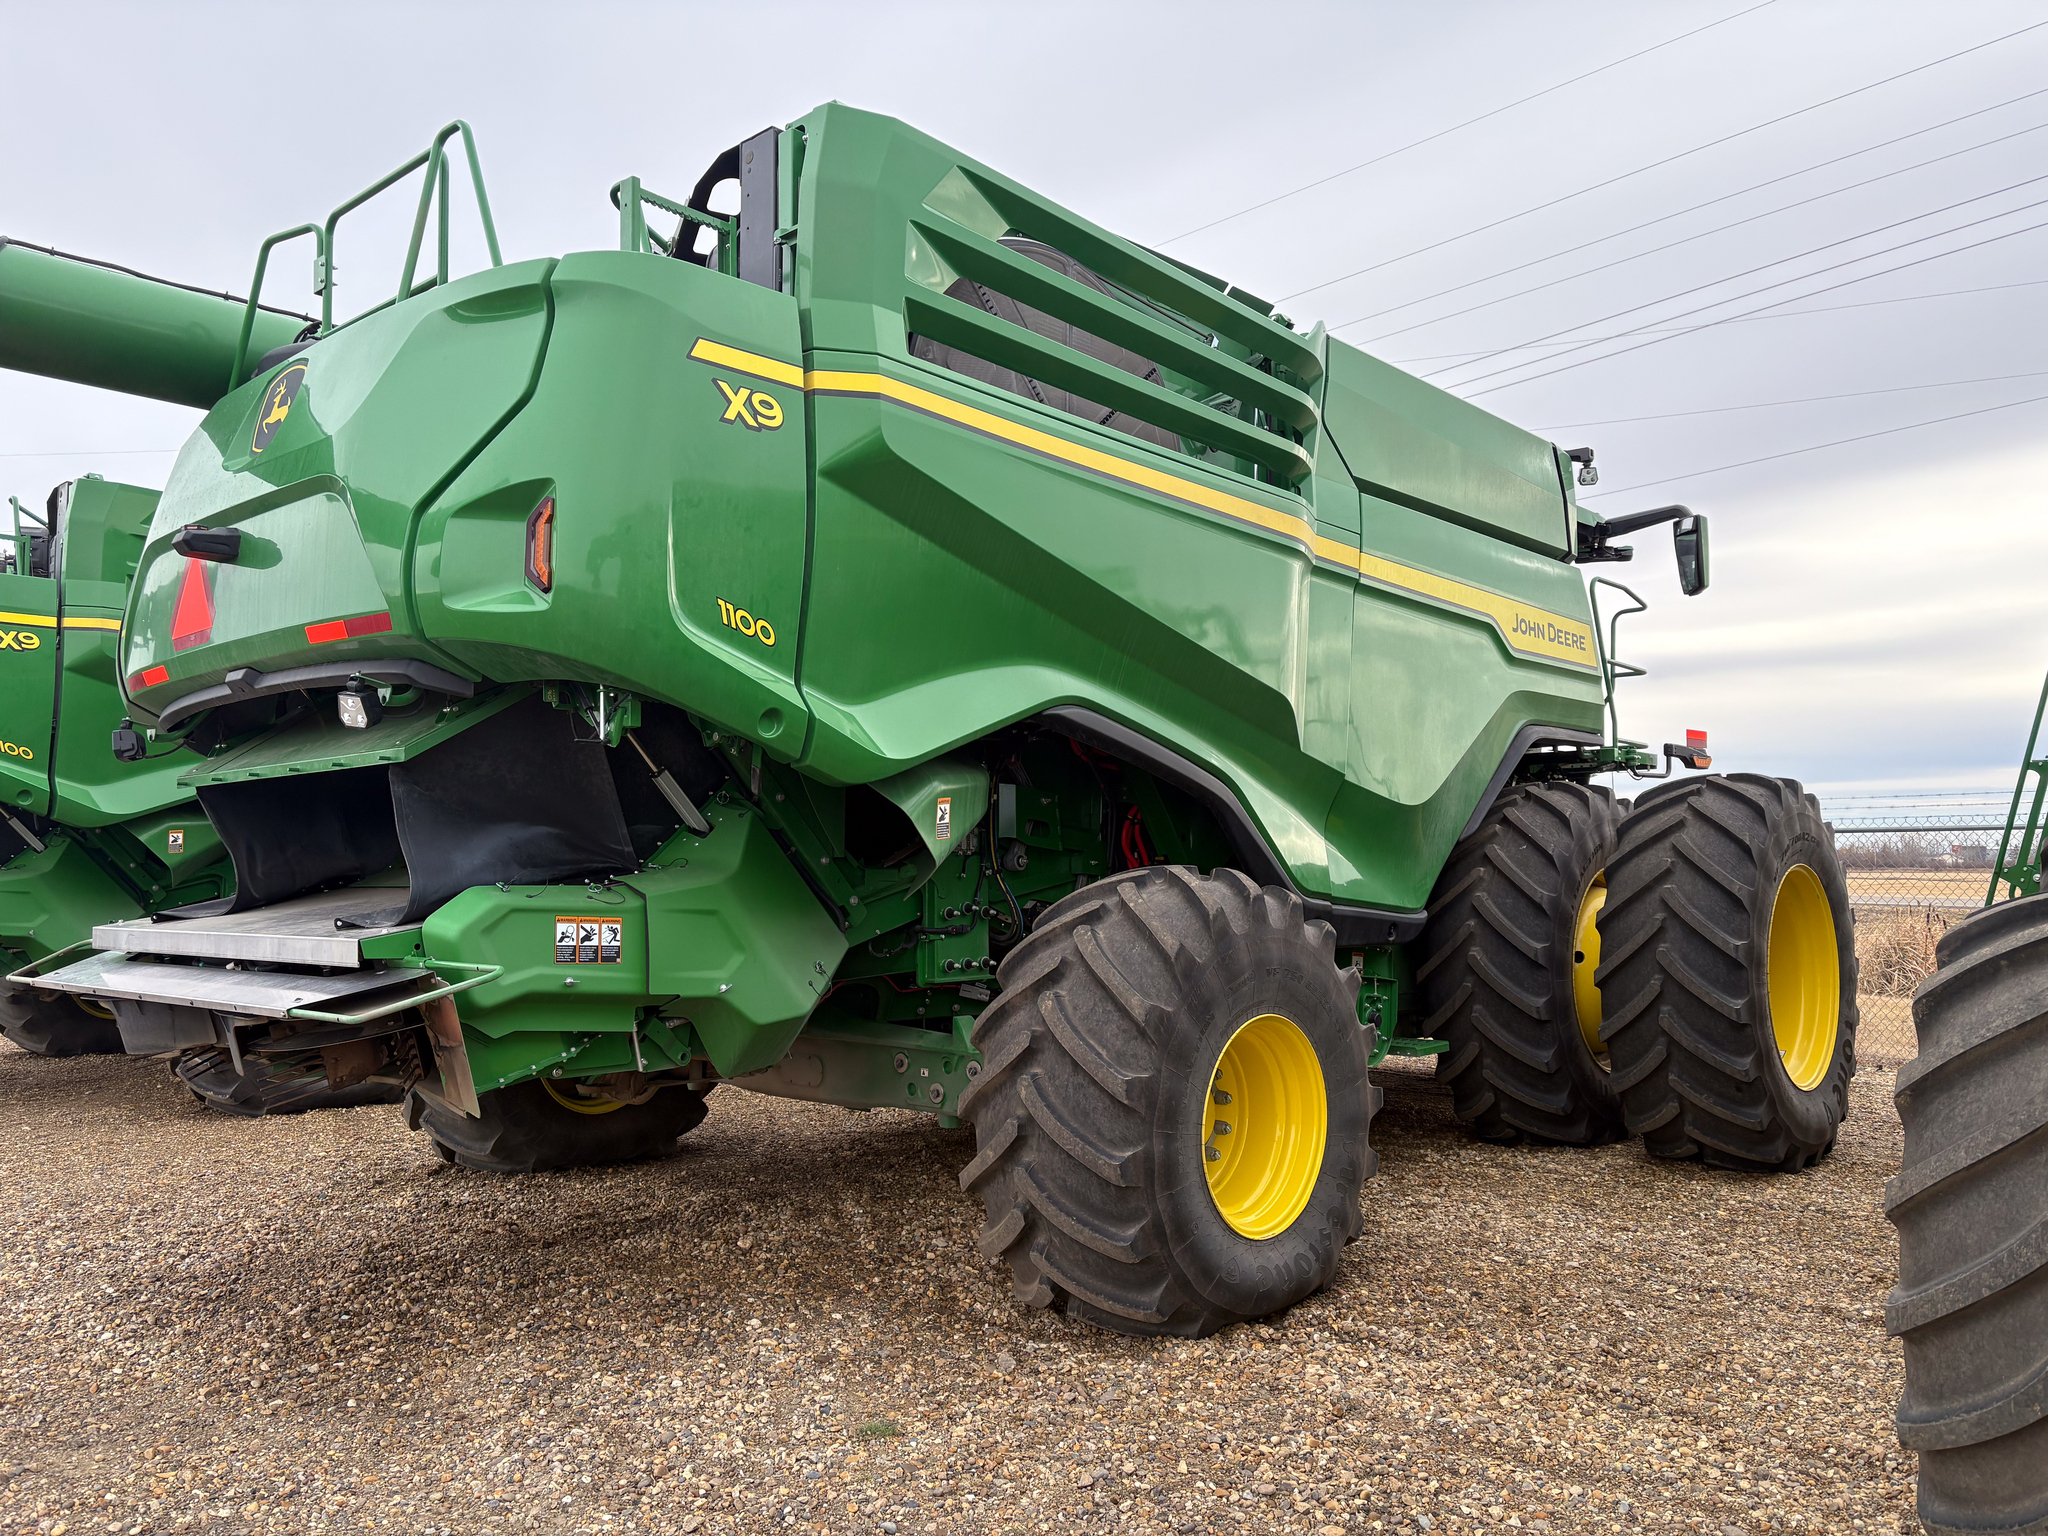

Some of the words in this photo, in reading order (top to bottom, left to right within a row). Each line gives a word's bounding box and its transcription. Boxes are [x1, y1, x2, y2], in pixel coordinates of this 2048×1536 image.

[711, 377, 784, 432] X9
[0, 630, 41, 652] X9
[716, 596, 776, 647] 1100
[1512, 613, 1546, 640] JOHN
[1547, 622, 1586, 651] DEERE
